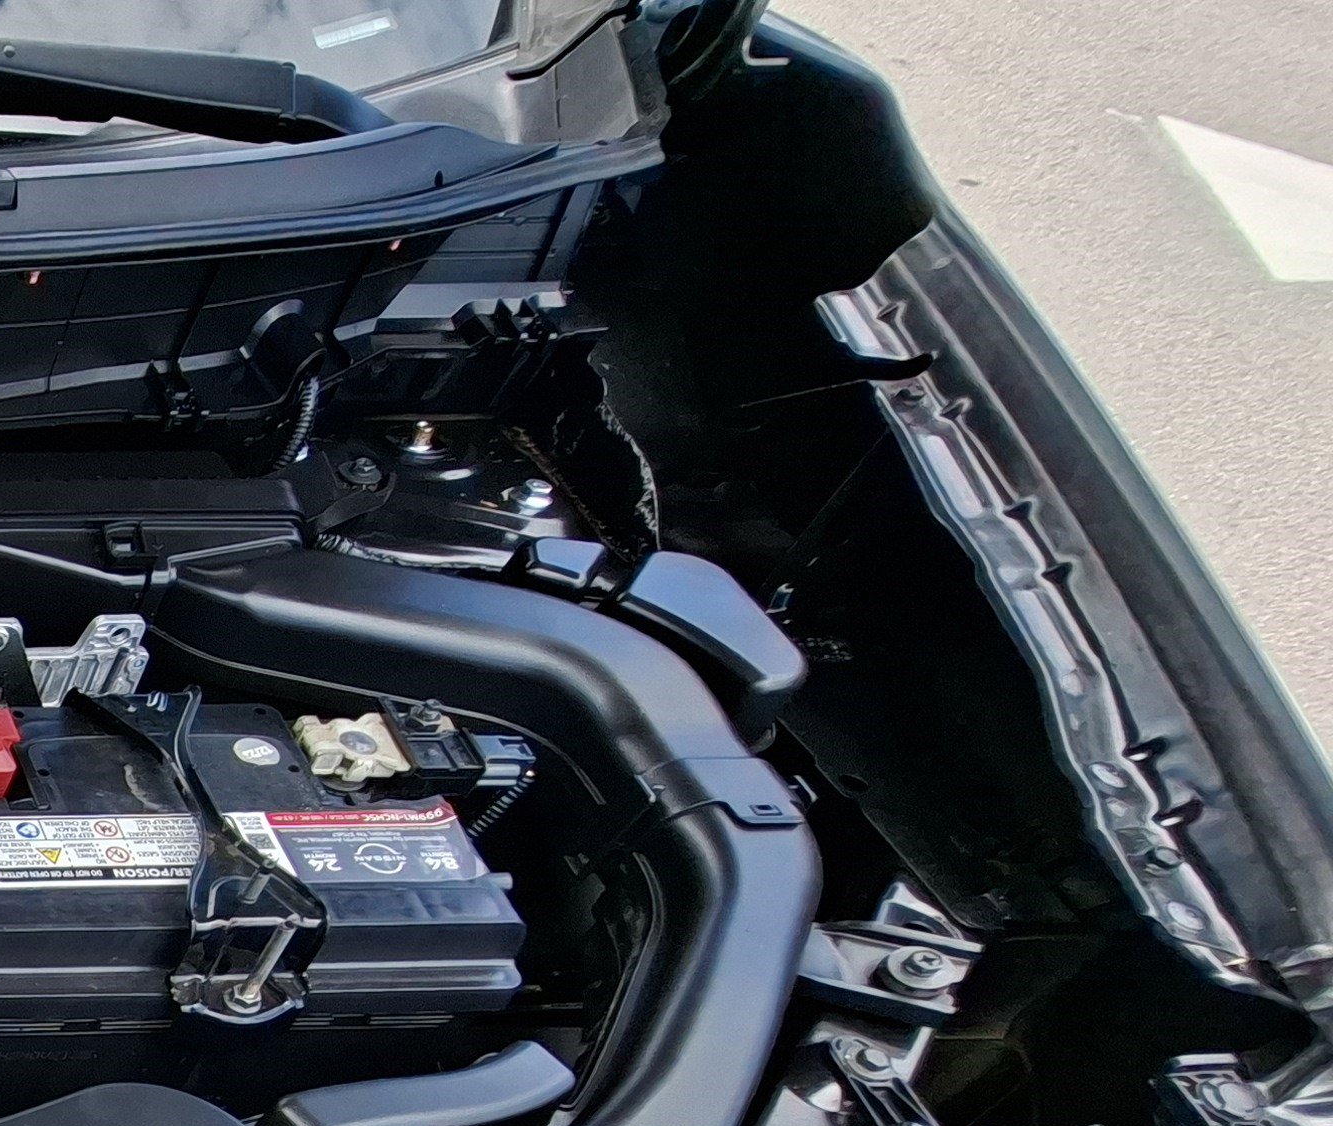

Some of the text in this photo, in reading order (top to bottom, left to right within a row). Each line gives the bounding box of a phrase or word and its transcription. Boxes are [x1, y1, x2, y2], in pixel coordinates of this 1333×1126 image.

[353, 854, 407, 862] NISSAN
[307, 857, 342, 872] 24
[424, 856, 459, 871] 84
[29, 870, 50, 878] OPEN
[75, 869, 91, 877] NOT
